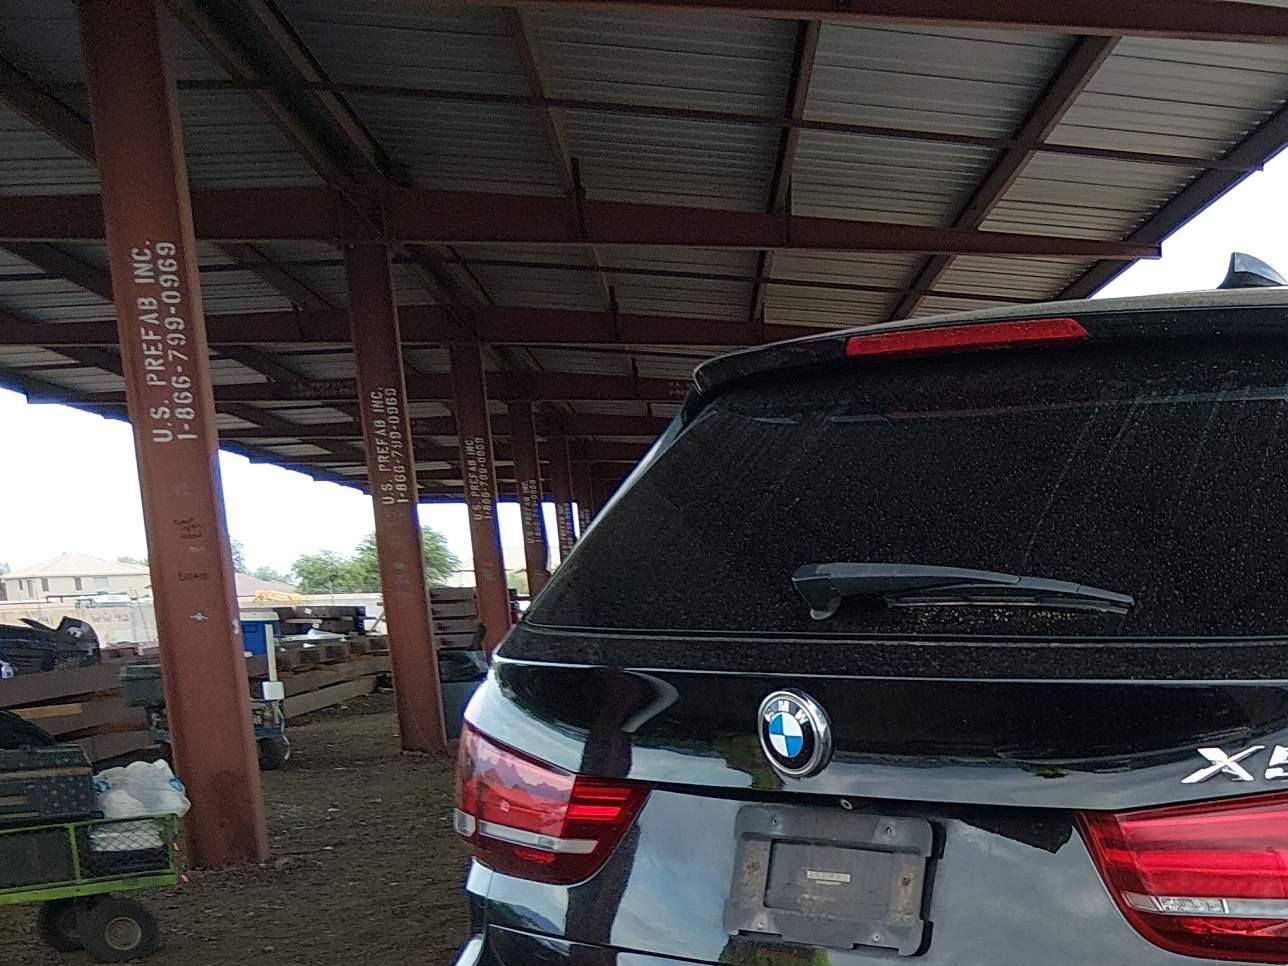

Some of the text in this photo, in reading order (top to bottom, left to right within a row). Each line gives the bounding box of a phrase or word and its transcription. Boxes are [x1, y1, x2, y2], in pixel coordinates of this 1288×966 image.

[132, 240, 173, 443] U.S. PREFAB INC.
[156, 241, 199, 440] 1-866-799-0969
